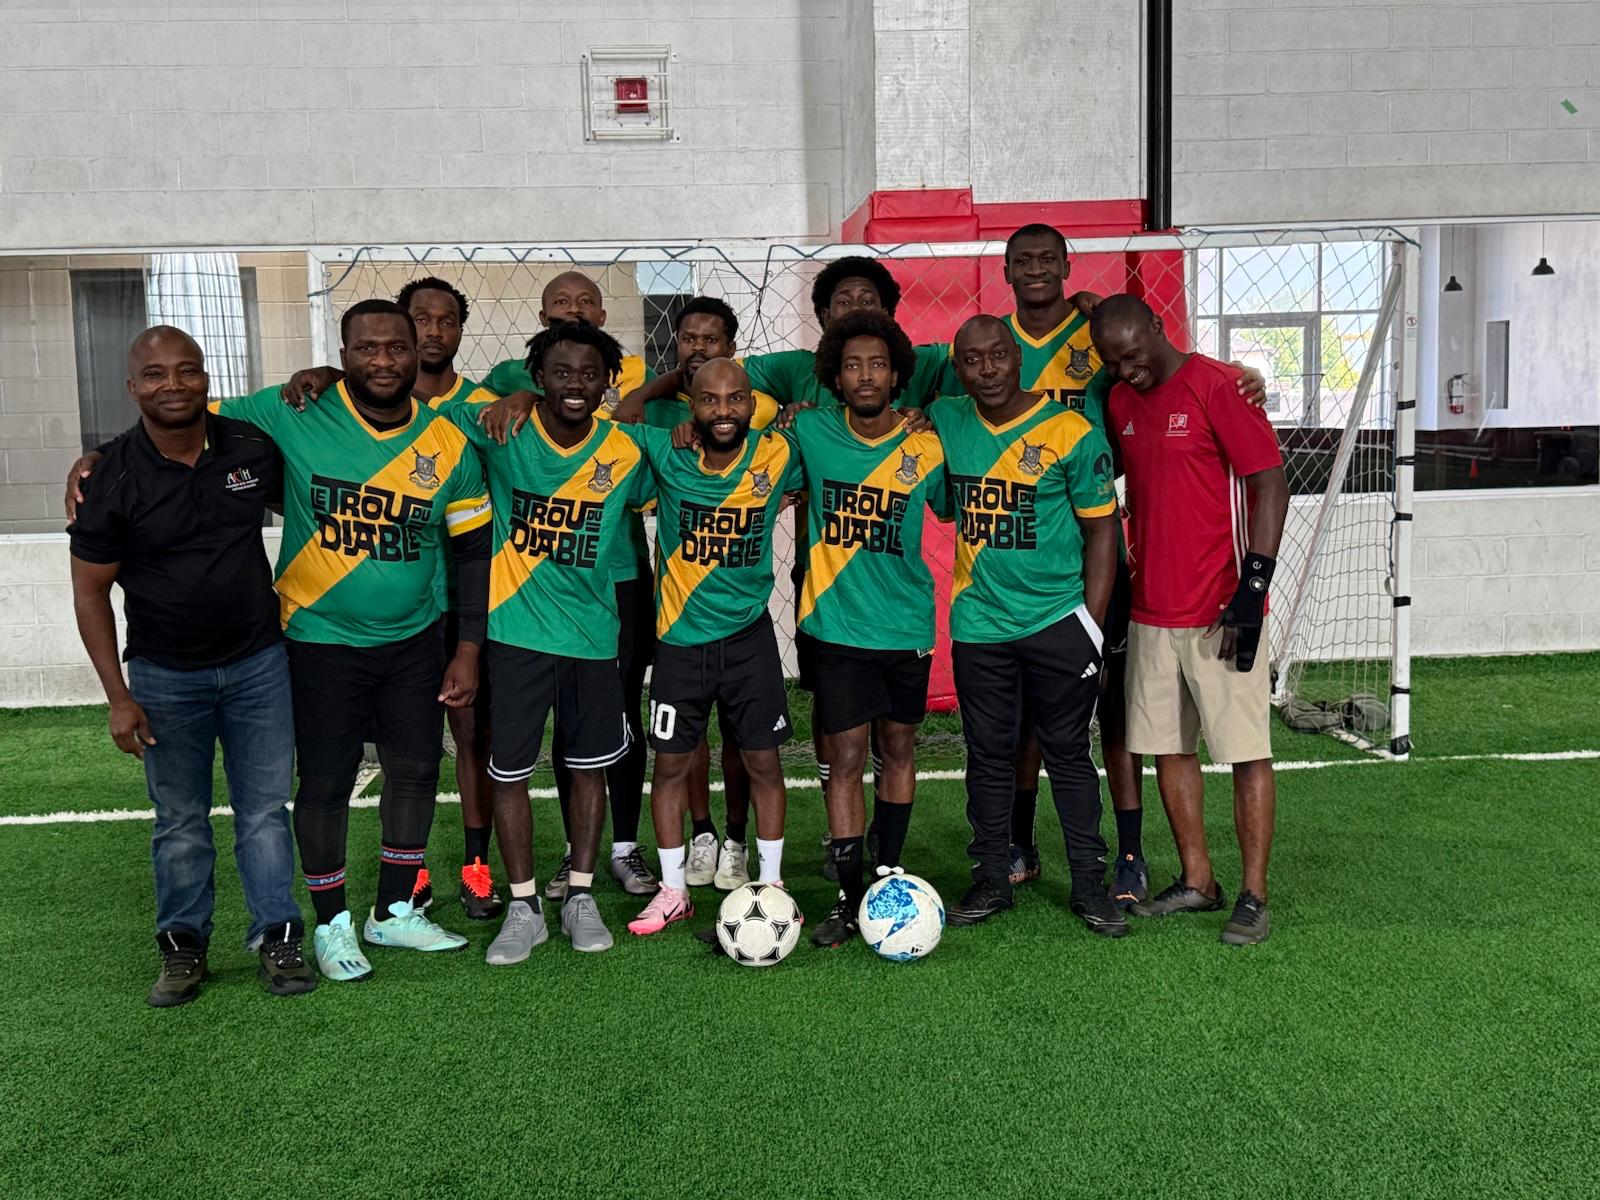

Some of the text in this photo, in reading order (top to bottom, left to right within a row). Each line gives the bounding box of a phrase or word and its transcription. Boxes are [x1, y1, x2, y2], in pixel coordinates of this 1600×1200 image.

[311, 474, 433, 525] LE TROU DU
[512, 488, 605, 530] TROU
[587, 510, 601, 521] DU
[823, 479, 910, 520] TROU
[894, 499, 907, 512] DU
[951, 474, 1037, 511] TROU
[1020, 492, 1035, 503] DU
[313, 511, 422, 562] DIABLE
[680, 500, 766, 535] TROU
[753, 514, 764, 523] DU
[823, 511, 904, 558] DIABLE
[509, 516, 599, 569] DIABLE
[679, 531, 763, 568] DIABLE
[650, 699, 677, 741] 10
[383, 850, 424, 860] NASA
